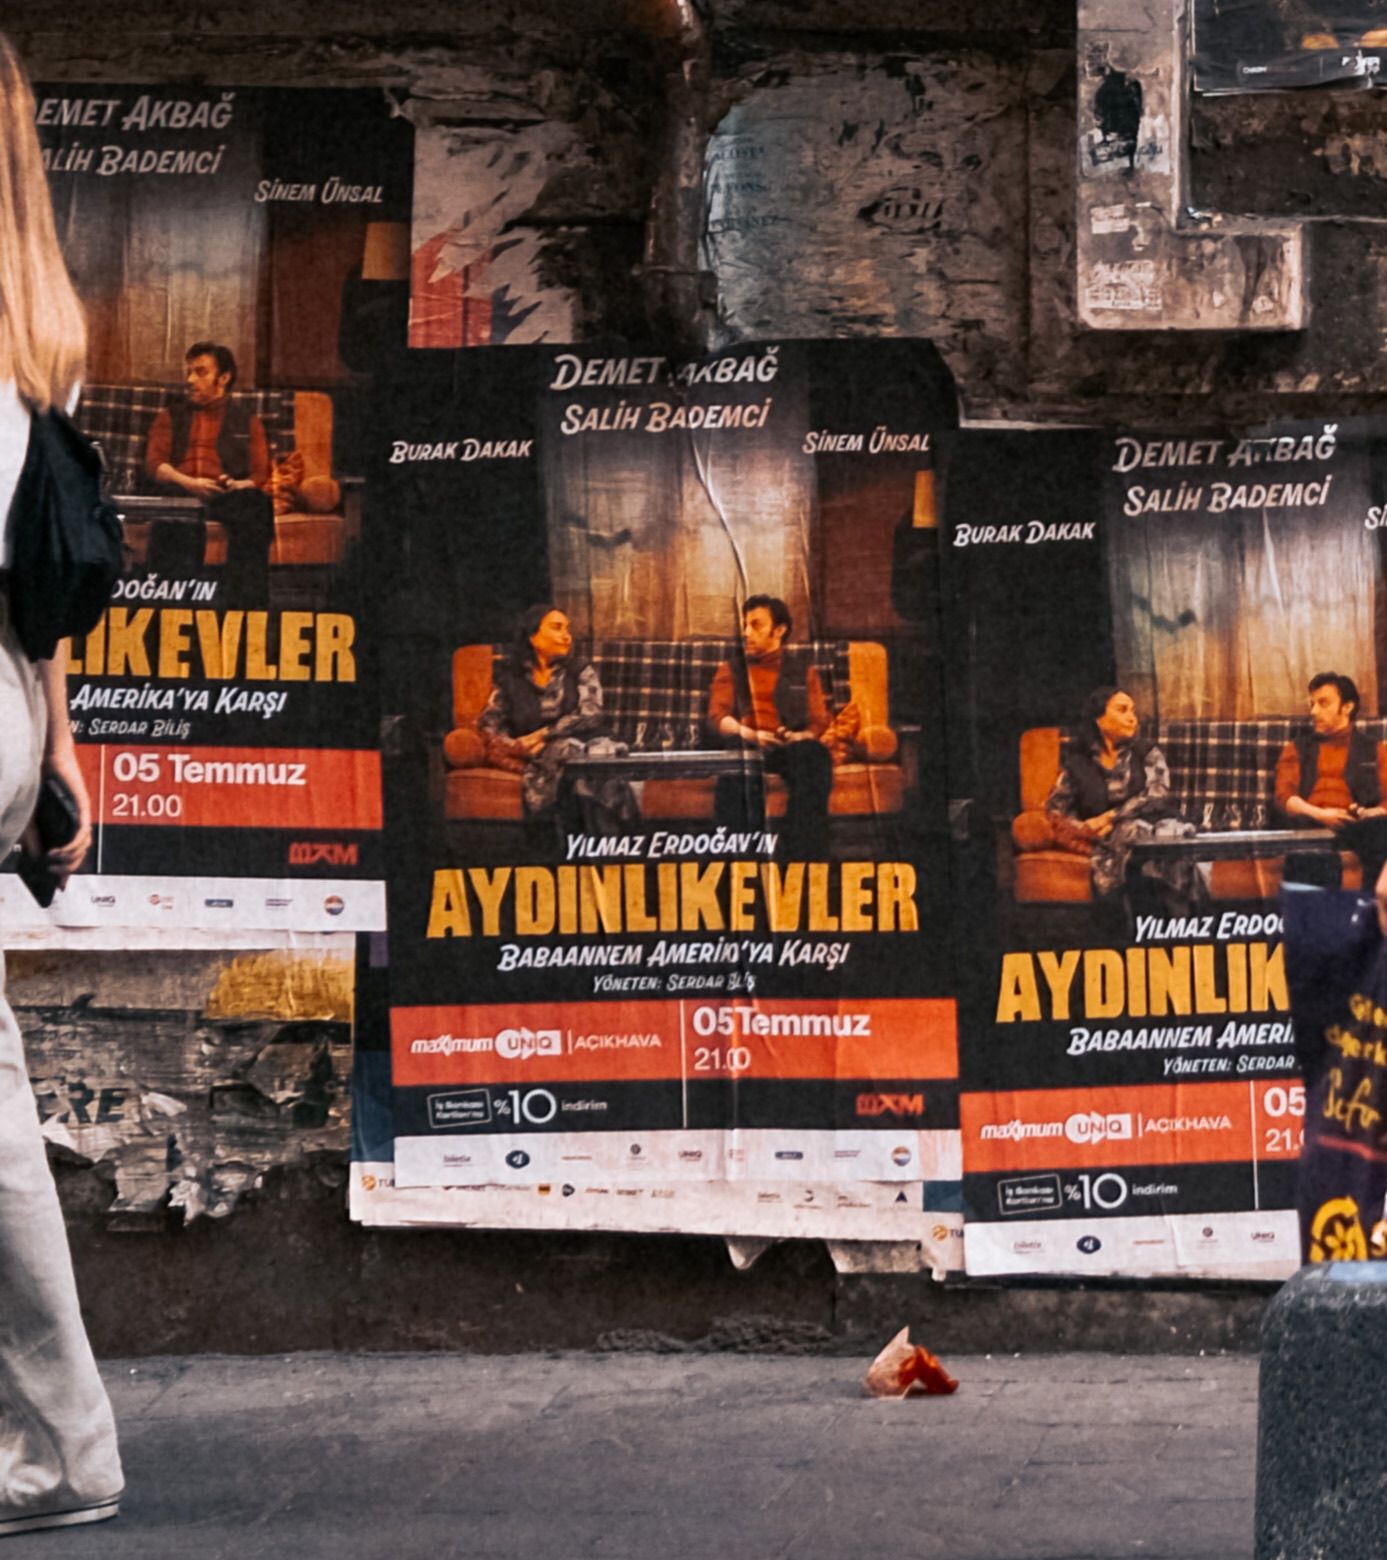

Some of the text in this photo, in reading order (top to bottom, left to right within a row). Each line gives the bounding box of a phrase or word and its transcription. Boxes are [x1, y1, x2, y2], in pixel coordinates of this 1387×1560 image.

[121, 92, 236, 131] AKBAĞ
[41, 142, 226, 176] ALİH BADEMCİ
[254, 177, 384, 204] SİNEM ÜNSAL
[550, 353, 668, 391] DEMET
[561, 397, 773, 435] SALİH BADEMCİ
[389, 438, 534, 464] BURAK DAKAK
[802, 426, 932, 454] SİNEM ÜNSAL
[1113, 438, 1222, 473] DEMET
[1124, 475, 1333, 516] SALİH BADEMCİ
[953, 520, 1096, 547] BURAK DAKAK
[70, 683, 288, 719] AMERİKA'YA KARŞI
[88, 719, 148, 736] SERDAR
[151, 719, 191, 739] BİLİŞ
[113, 753, 307, 786] 05 Temmuz
[112, 793, 183, 817] 21.00
[566, 833, 644, 860] YILMAZ
[426, 861, 919, 939] AYDINLIKEVLER
[1135, 915, 1211, 942] YILMAZ
[498, 943, 643, 972] BABAANNEM
[778, 940, 849, 972] KARŞI
[593, 974, 663, 993] YÖNETEN:
[666, 973, 724, 991] SERDAR
[693, 1006, 871, 1037] 05 Temmuz
[574, 1034, 662, 1052] AÇIKHAVA
[1066, 1017, 1295, 1055] BABAANNEM AMERİ
[694, 1047, 750, 1071] 21.00
[1163, 1055, 1296, 1076] YÖNETEN: SERDAR
[561, 1100, 608, 1111] indirim
[1263, 1087, 1305, 1117] 05
[1144, 1115, 1232, 1134] AÇIKHAVA
[1132, 1183, 1178, 1196] indirim
